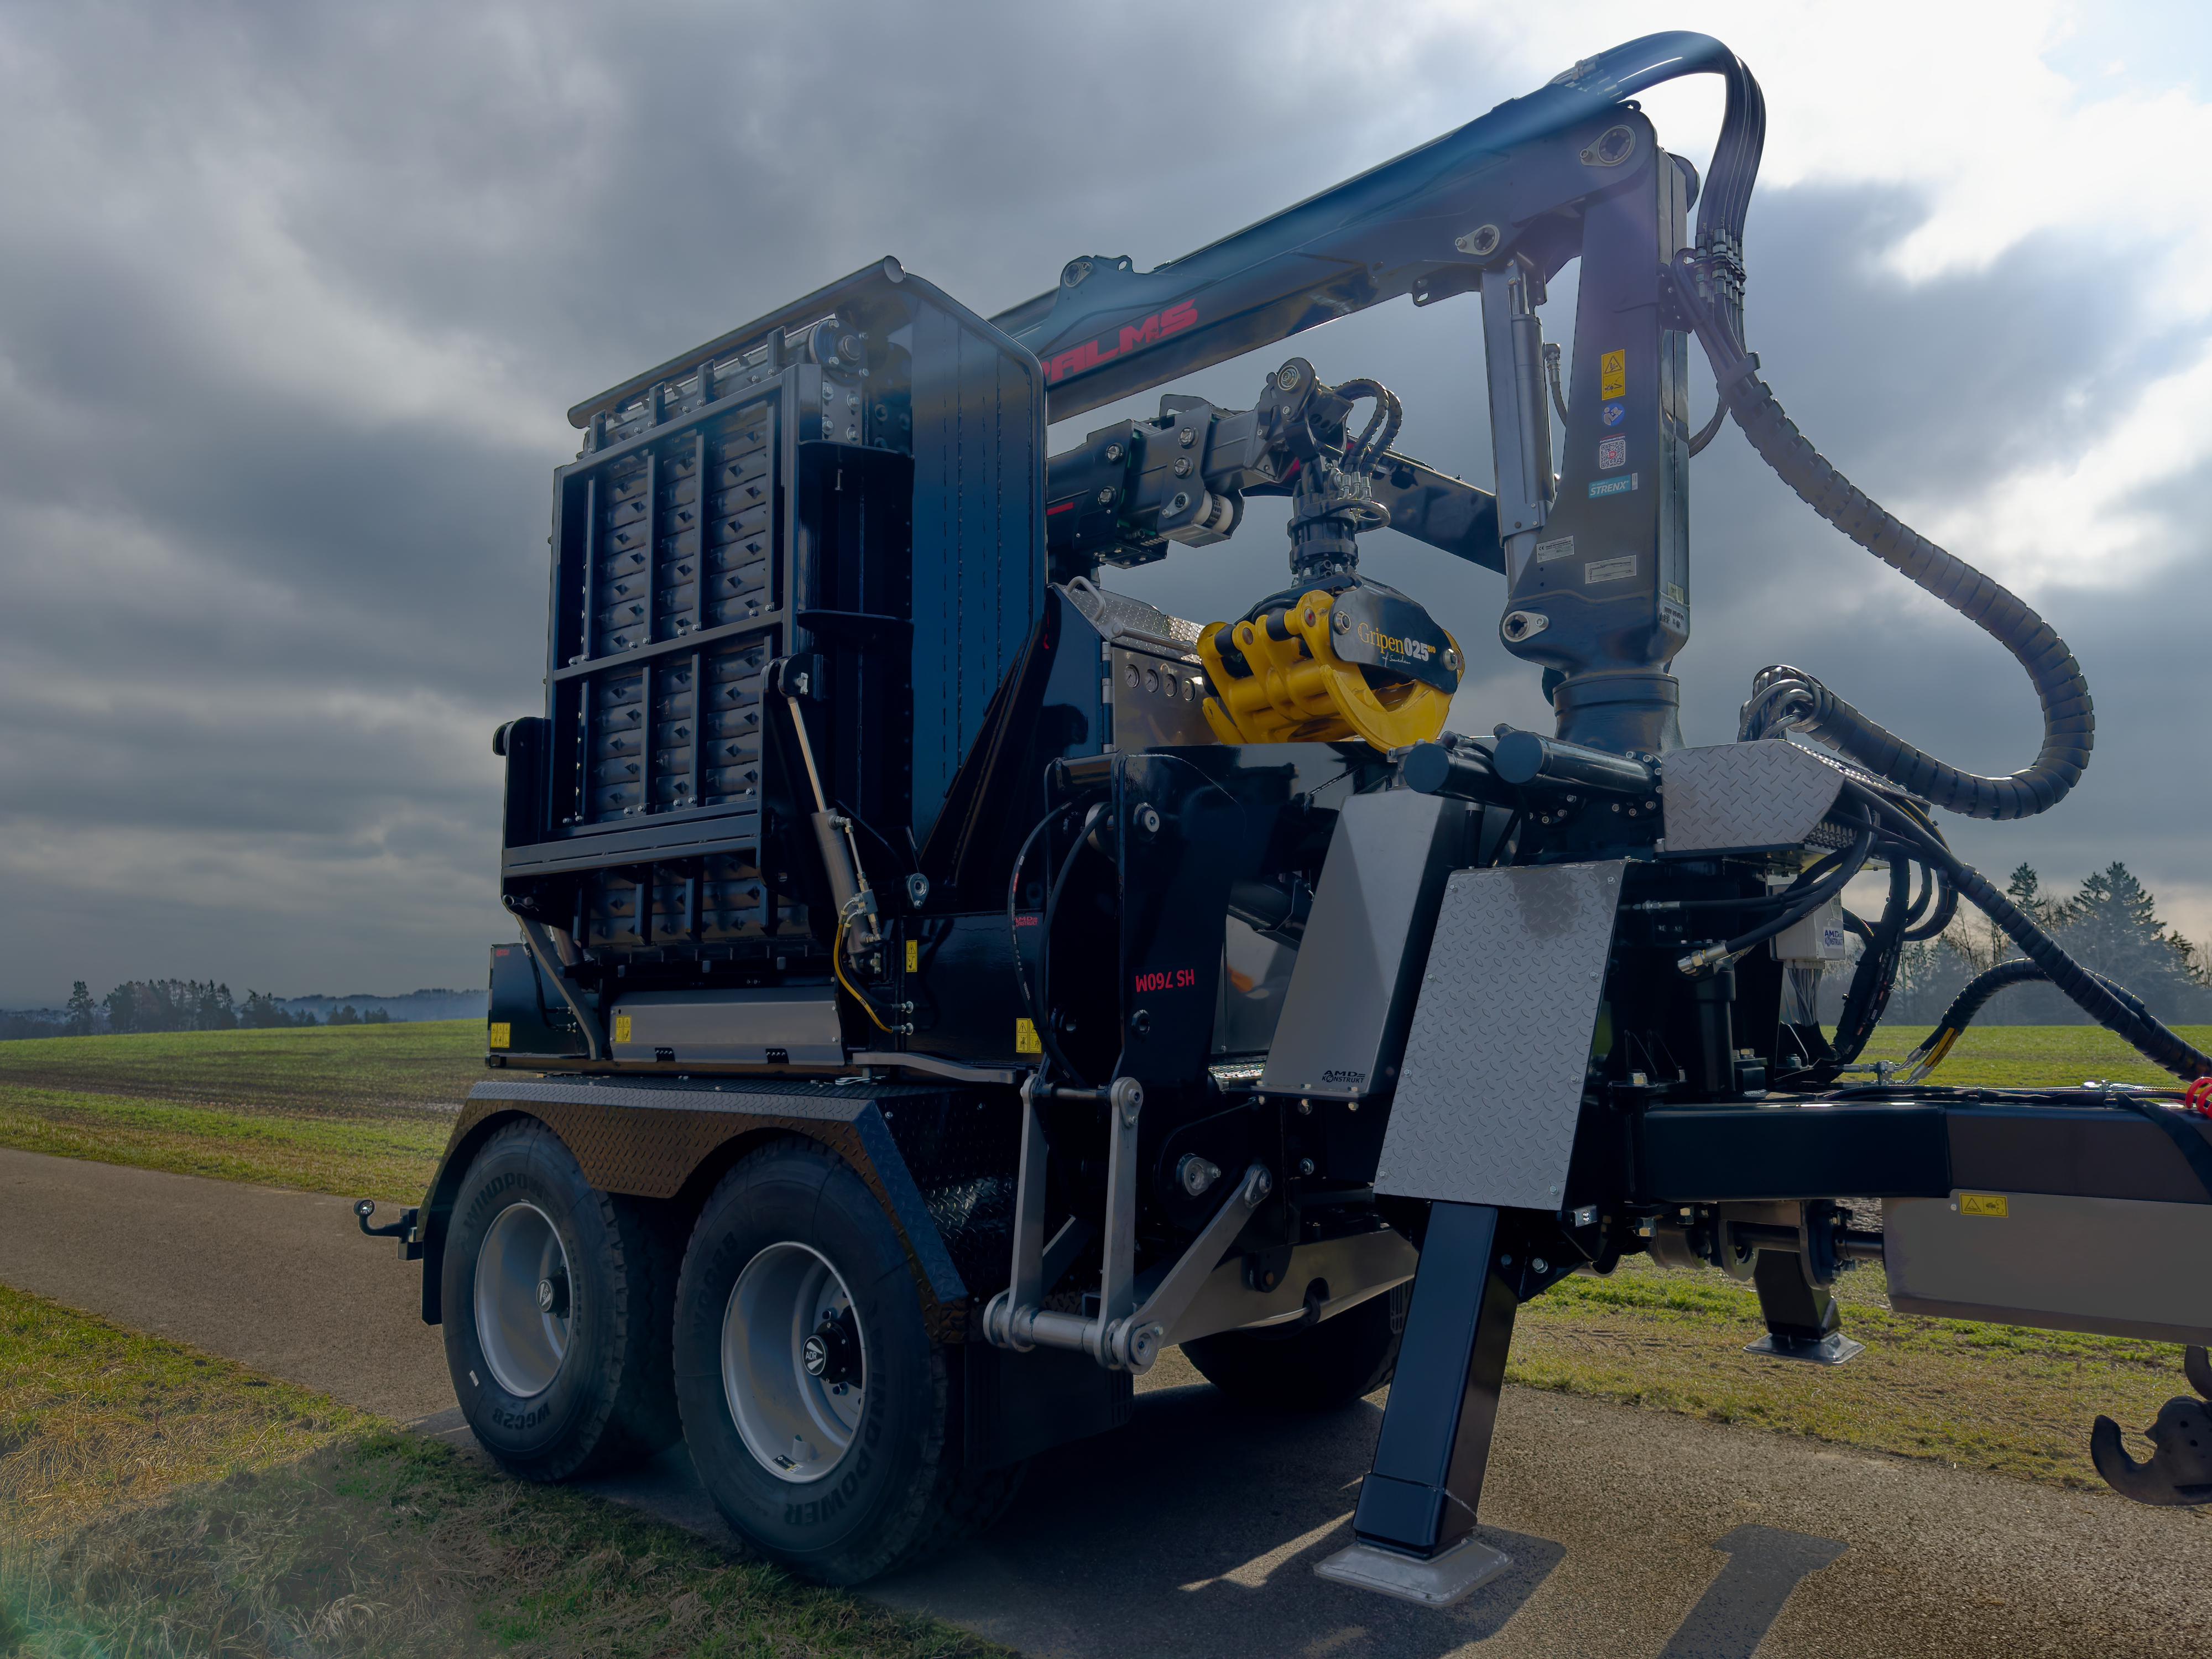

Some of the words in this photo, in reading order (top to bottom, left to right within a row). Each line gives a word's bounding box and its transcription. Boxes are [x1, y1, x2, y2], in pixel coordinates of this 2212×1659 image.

[1590, 481, 1627, 495] STRENX
[1404, 637, 1429, 661] 025
[1135, 971, 1173, 993] 760M
[1176, 968, 1196, 987] HS
[805, 1351, 817, 1365] ADR
